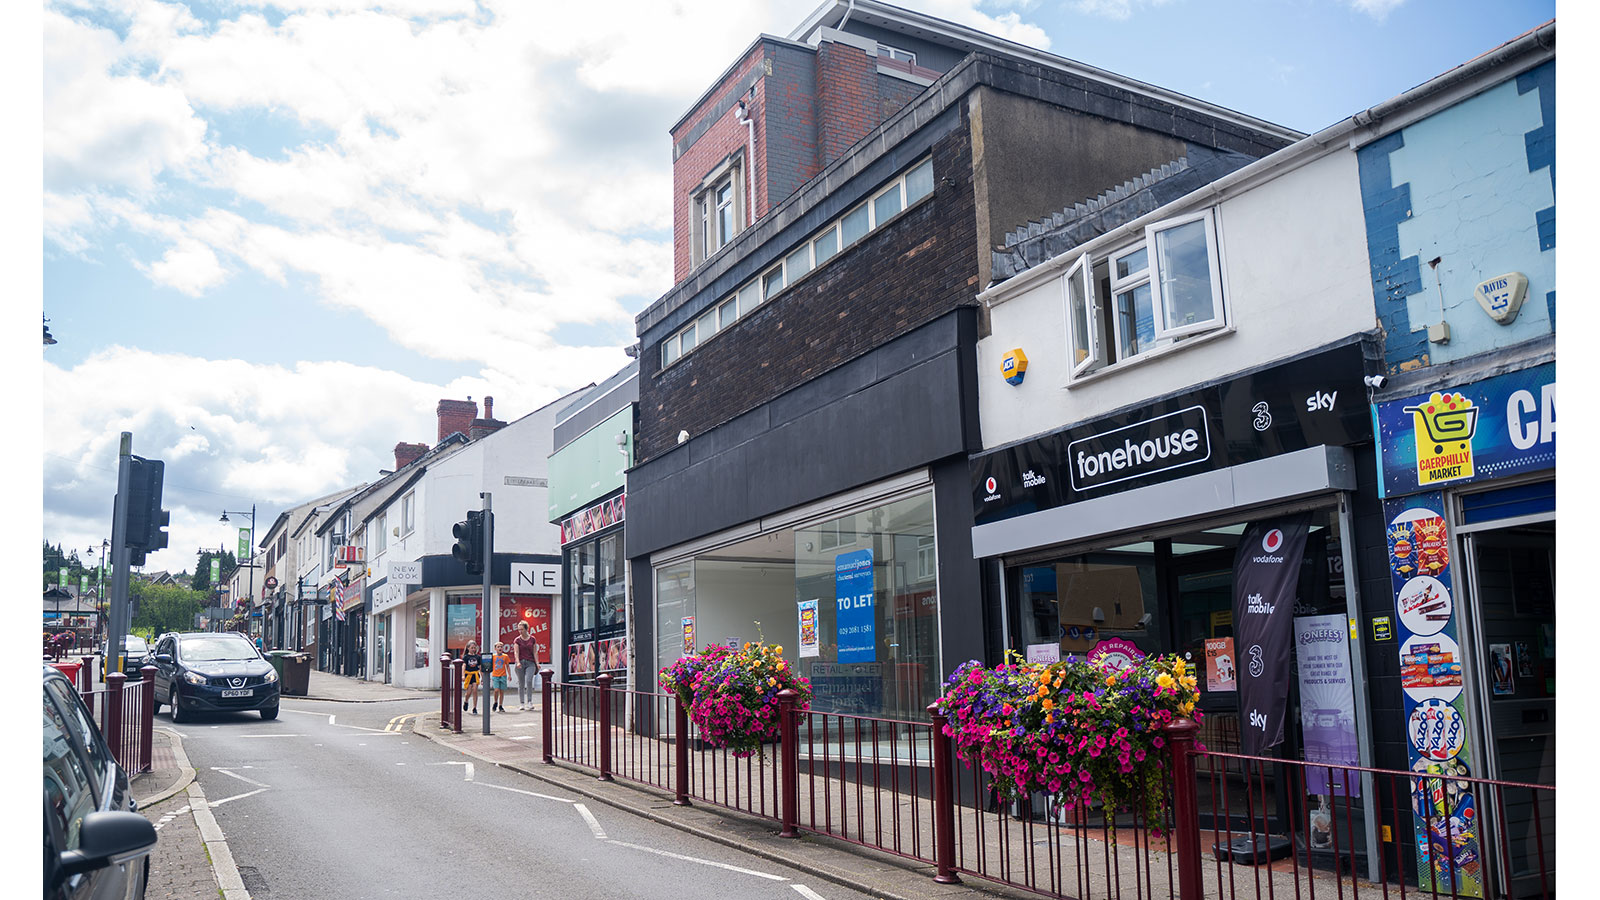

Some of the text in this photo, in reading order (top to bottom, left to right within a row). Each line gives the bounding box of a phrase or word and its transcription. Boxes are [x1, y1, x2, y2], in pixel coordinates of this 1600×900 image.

[1483, 278, 1508, 294] DAVIES
[1306, 389, 1338, 412] sky
[1252, 401, 1272, 431] 3
[1077, 428, 1199, 479] fonehouse
[1420, 451, 1470, 471] CAERPHILLY
[1022, 470, 1036, 481] talk
[1429, 466, 1462, 480] MARKET
[1024, 475, 1046, 488] mobile
[984, 494, 1002, 502] vodafone
[1253, 555, 1284, 563] vodafone
[837, 594, 873, 610] TO LET
[1247, 593, 1263, 605] talk
[1247, 602, 1275, 614] mobile
[500, 623, 518, 635] ALE
[530, 622, 547, 635] ALE
[1300, 629, 1344, 643] FONEFEST
[1206, 641, 1226, 650] 100GB
[813, 665, 843, 674] RETAIL
[864, 665, 880, 674] LET
[1250, 709, 1267, 731] sky
[1416, 712, 1428, 750] YAZOO
[1430, 711, 1444, 750] YAZOO
[1446, 712, 1460, 750] YAZOO
